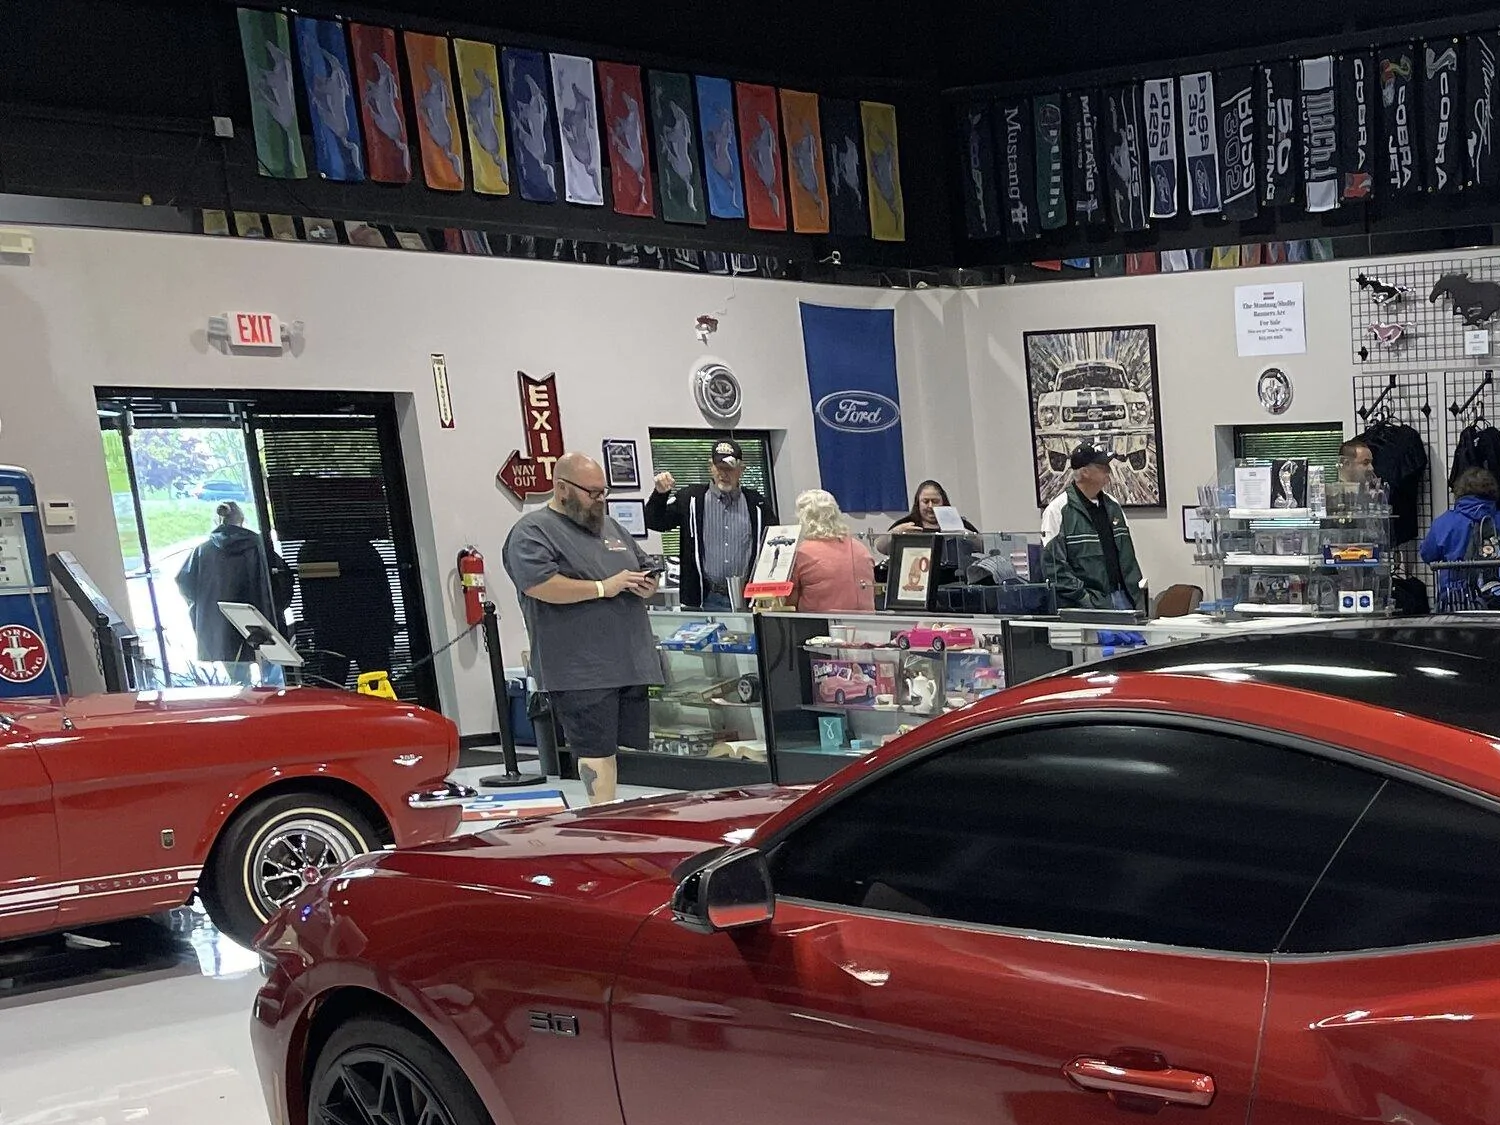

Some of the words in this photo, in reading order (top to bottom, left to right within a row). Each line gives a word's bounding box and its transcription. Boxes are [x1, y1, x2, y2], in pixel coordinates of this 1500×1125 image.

[1080, 96, 1096, 193] MUSTANG
[1148, 92, 1159, 149] 429
[1188, 93, 1198, 136] 351
[1263, 68, 1276, 200] MUSTANG
[1301, 95, 1310, 180] MUSTANG
[1353, 58, 1368, 171] COBRA
[1396, 85, 1412, 187] COBRA
[1434, 71, 1451, 190] COBRA
[1005, 106, 1022, 200] Mustang
[1196, 169, 1207, 200] Ford
[1223, 107, 1241, 196] 302
[1388, 135, 1401, 189] JET
[236, 313, 273, 345] EXIT
[528, 384, 558, 480] EXIT
[835, 399, 882, 424] Ford
[512, 464, 536, 476] WAY
[514, 476, 537, 487] OUT
[84, 873, 173, 892] MUSTANG
